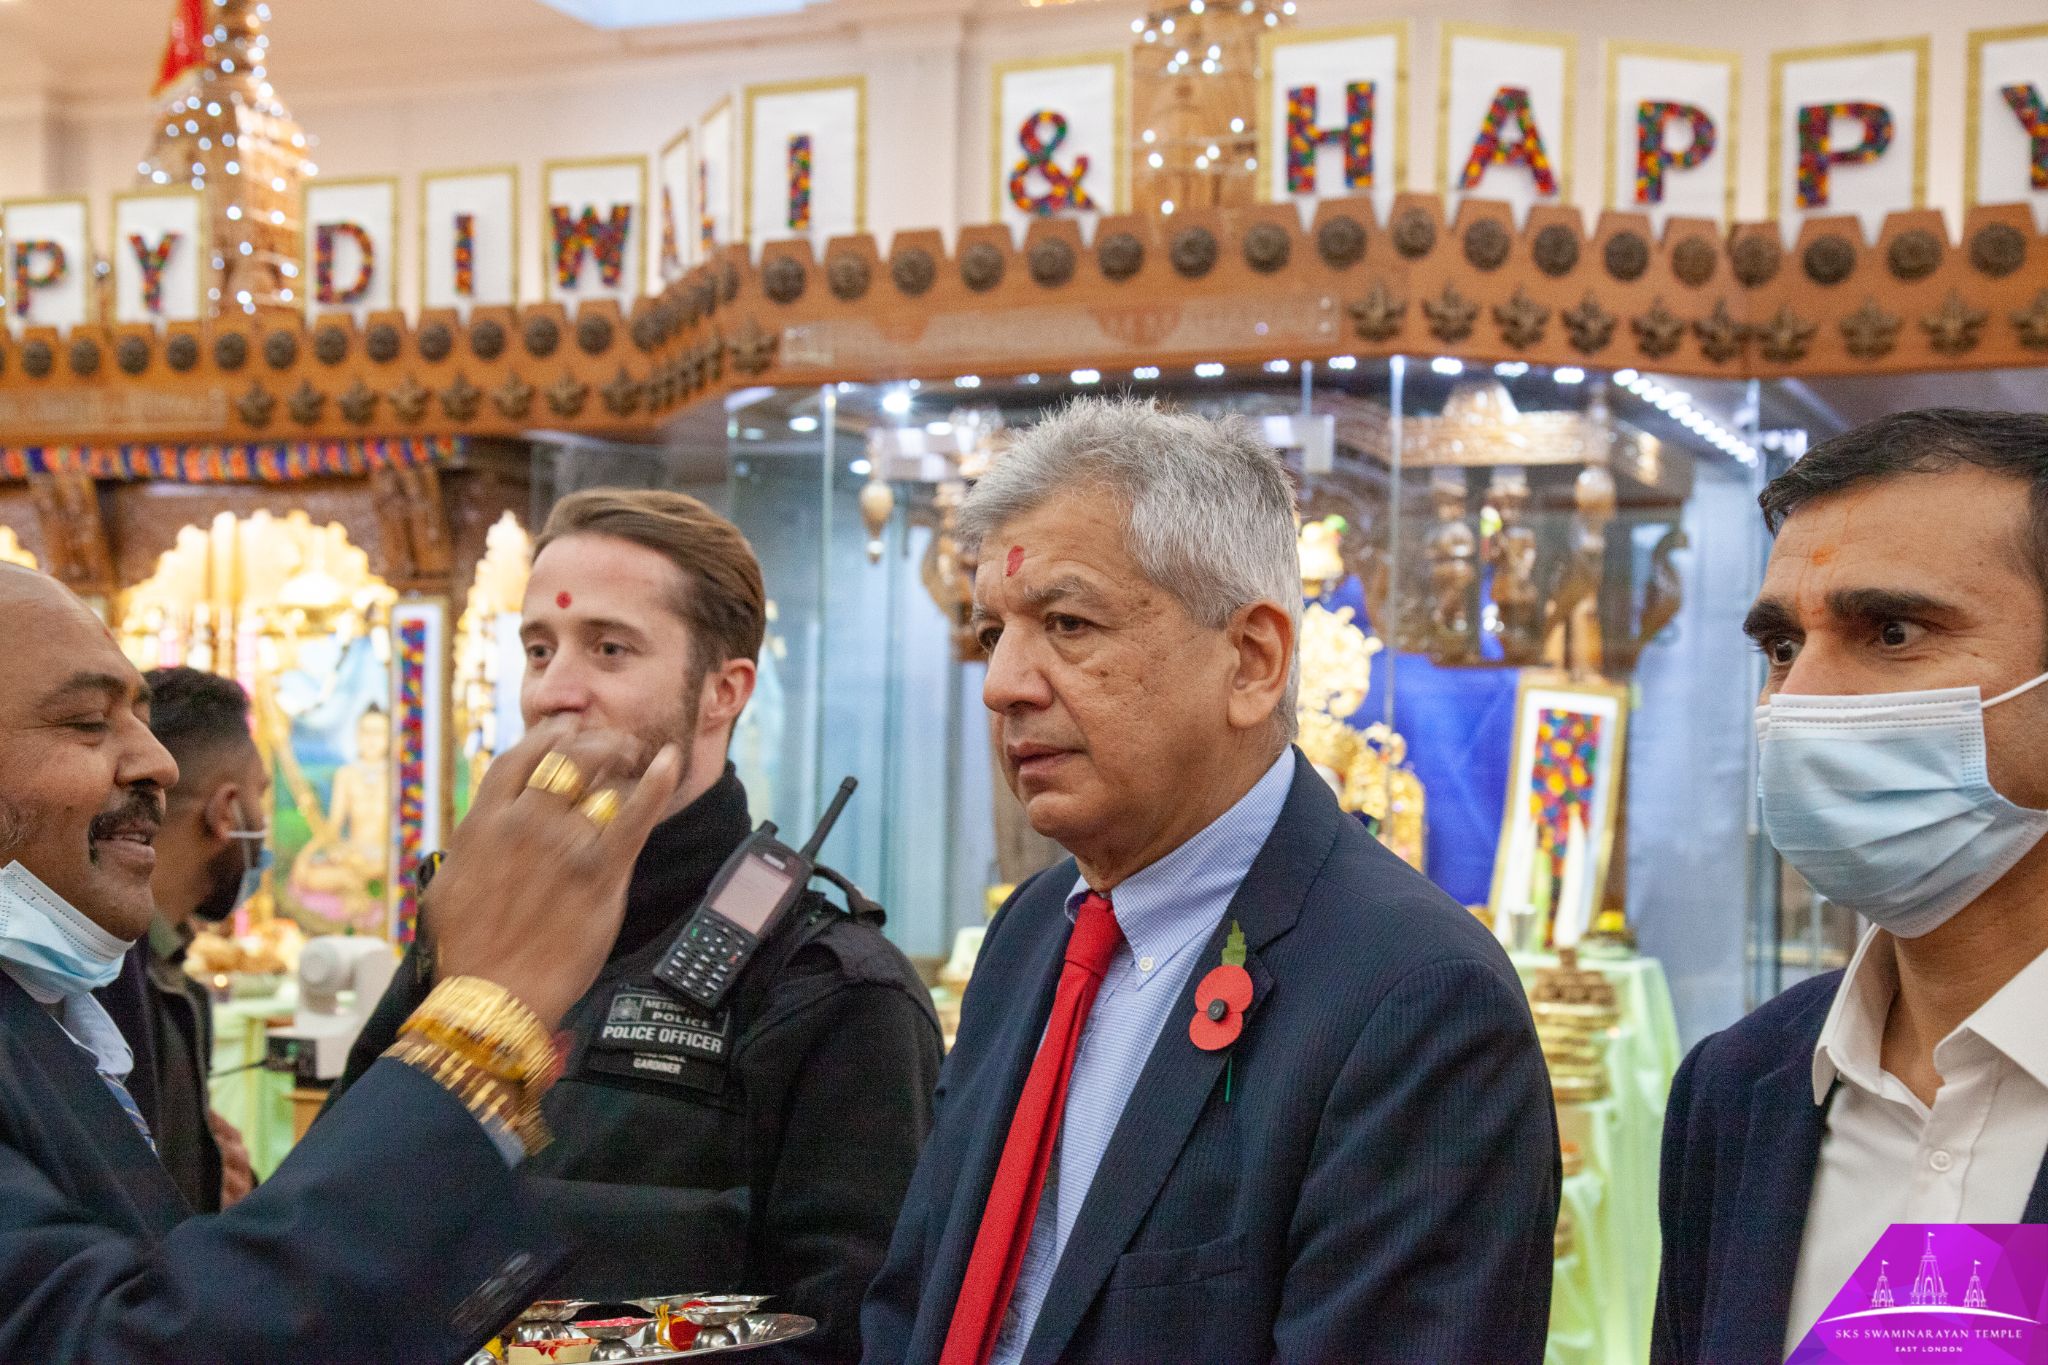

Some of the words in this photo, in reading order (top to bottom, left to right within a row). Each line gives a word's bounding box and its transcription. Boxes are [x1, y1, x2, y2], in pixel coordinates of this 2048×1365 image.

[1009, 109, 1096, 215] &
[652, 1011, 709, 1028] POLICE
[602, 1026, 656, 1040] POLICE
[658, 1028, 721, 1053] OFFICER
